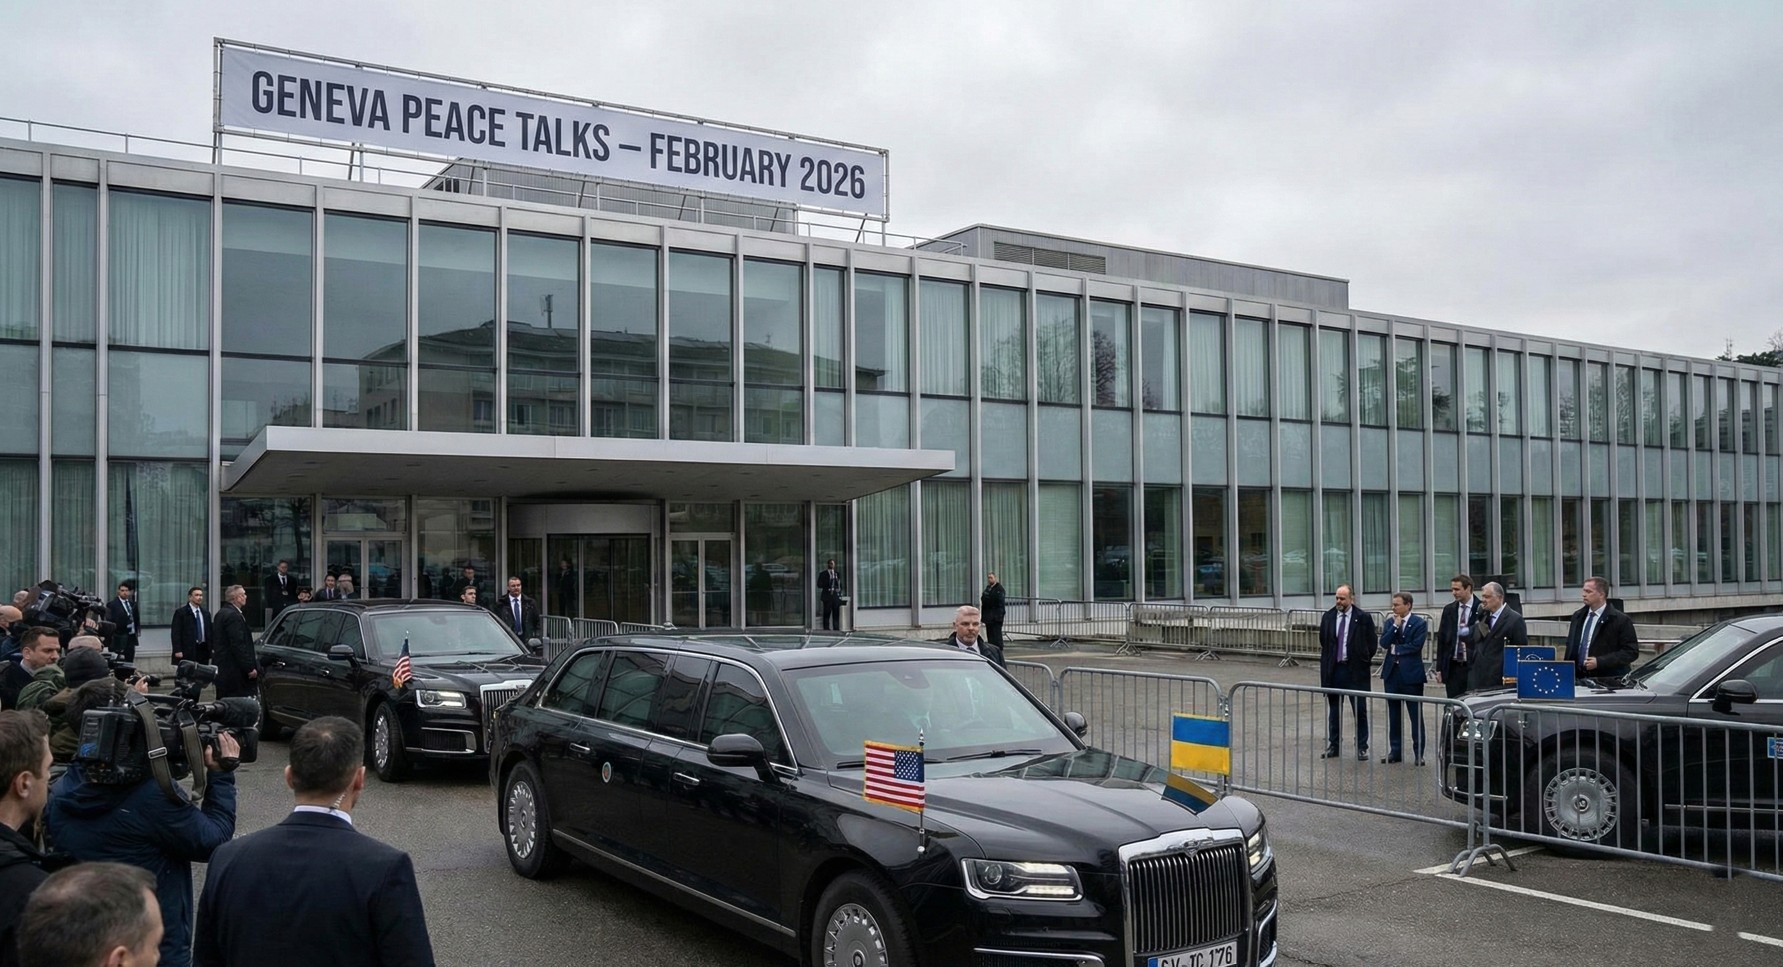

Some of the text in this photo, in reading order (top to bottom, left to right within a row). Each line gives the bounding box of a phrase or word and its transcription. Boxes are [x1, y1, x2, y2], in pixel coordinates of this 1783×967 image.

[251, 70, 391, 132] GENEVA
[402, 93, 506, 148] PEACE
[515, 111, 610, 162] TALKS
[650, 132, 792, 188] FEBRUARY
[799, 156, 866, 200] 2026
